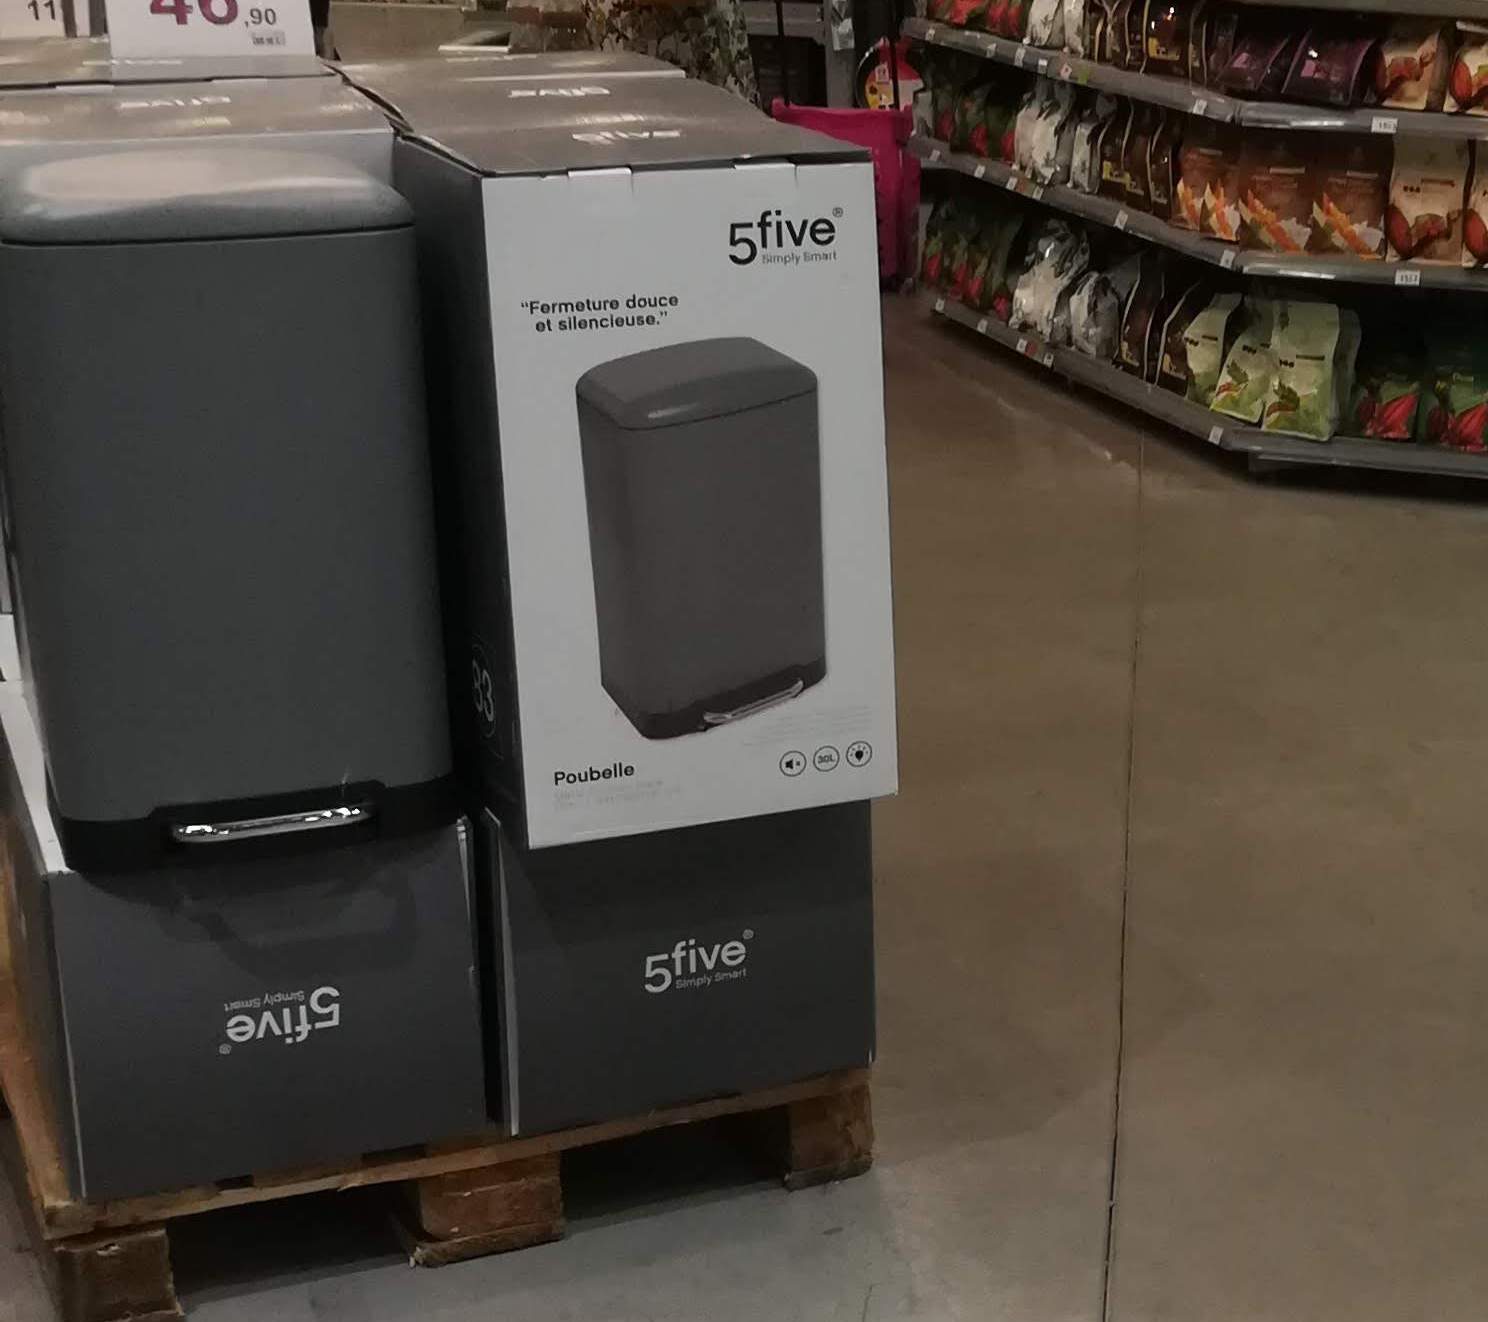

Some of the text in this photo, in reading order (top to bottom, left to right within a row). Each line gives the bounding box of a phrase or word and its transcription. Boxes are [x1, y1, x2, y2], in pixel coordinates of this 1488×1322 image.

[728, 209, 836, 266] 5five
[761, 253, 801, 266] Simply
[626, 293, 679, 309] douce
[535, 319, 552, 332] et
[554, 761, 635, 787] Poubelle
[645, 939, 747, 993] 5five
